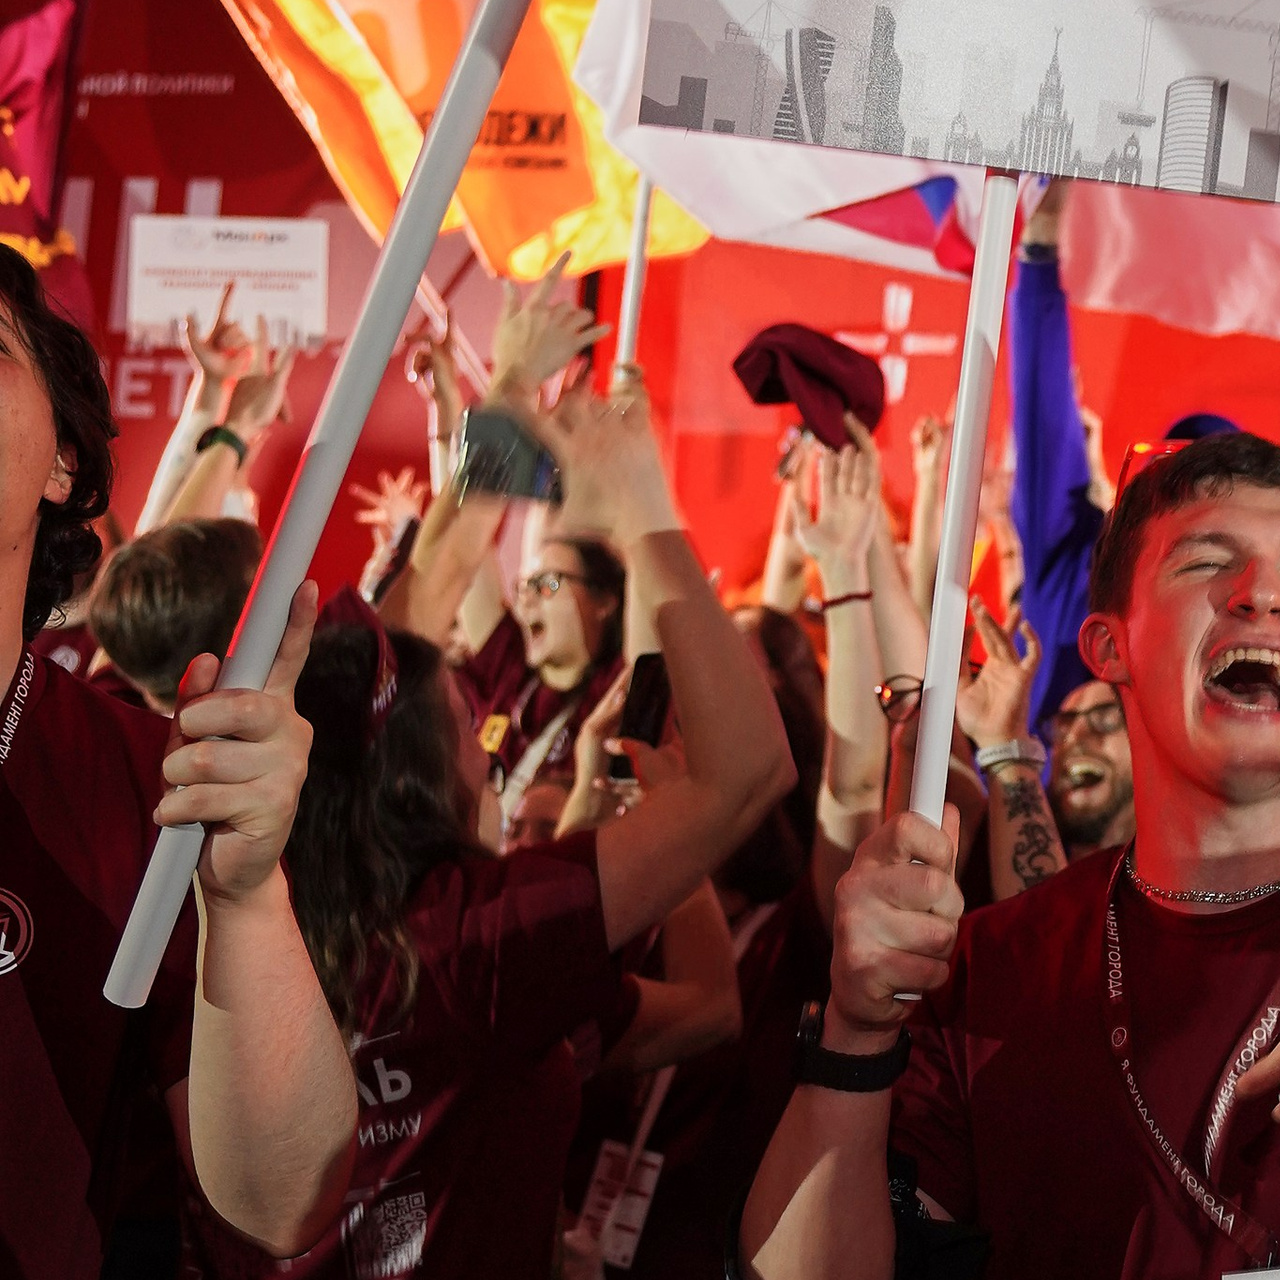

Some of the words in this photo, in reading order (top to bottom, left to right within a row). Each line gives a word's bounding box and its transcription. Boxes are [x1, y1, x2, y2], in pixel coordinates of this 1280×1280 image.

[14, 652, 35, 705] ГОРОДА
[1108, 943, 1123, 999] ГОРОДА
[1120, 1059, 1130, 1071] Я
[1126, 1072, 1183, 1174] ФУНДАМЕНТ
[1181, 1167, 1235, 1236] ГОРОДА
